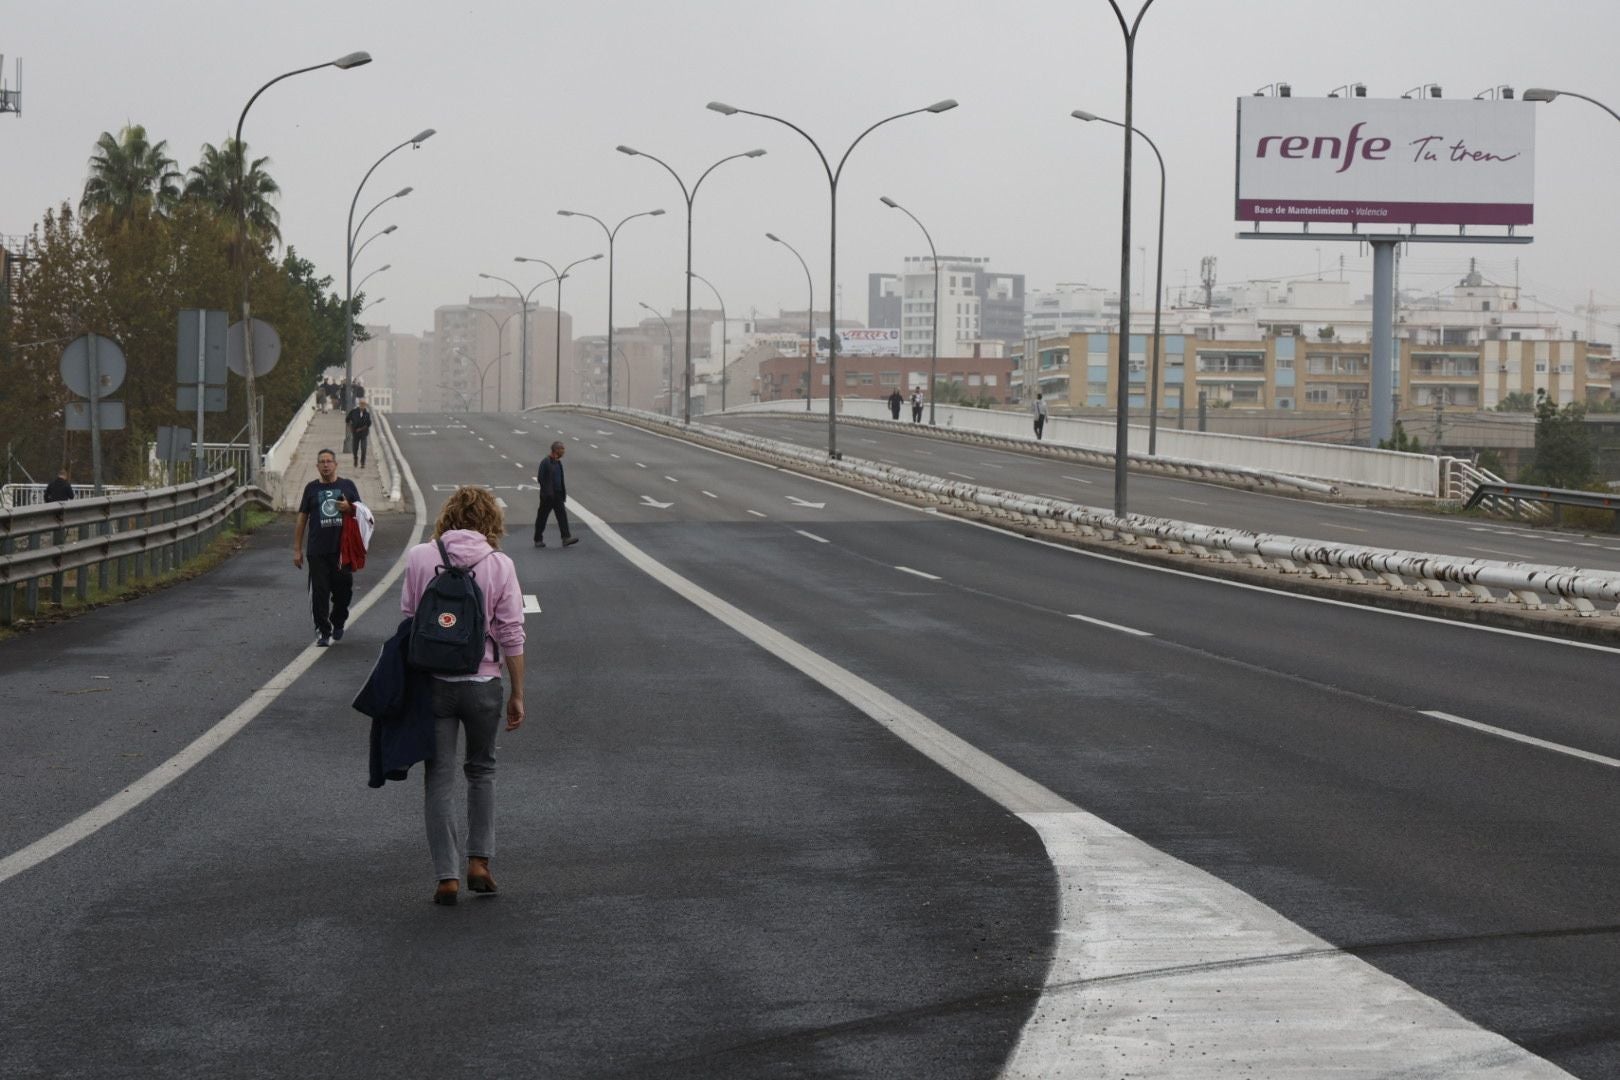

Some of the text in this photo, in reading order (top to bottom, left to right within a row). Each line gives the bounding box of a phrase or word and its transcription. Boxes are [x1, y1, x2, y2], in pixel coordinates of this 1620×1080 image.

[1255, 121, 1520, 174] renfe Tu tren
[1254, 205, 1388, 217] Base de Mantenimiento Valencia
